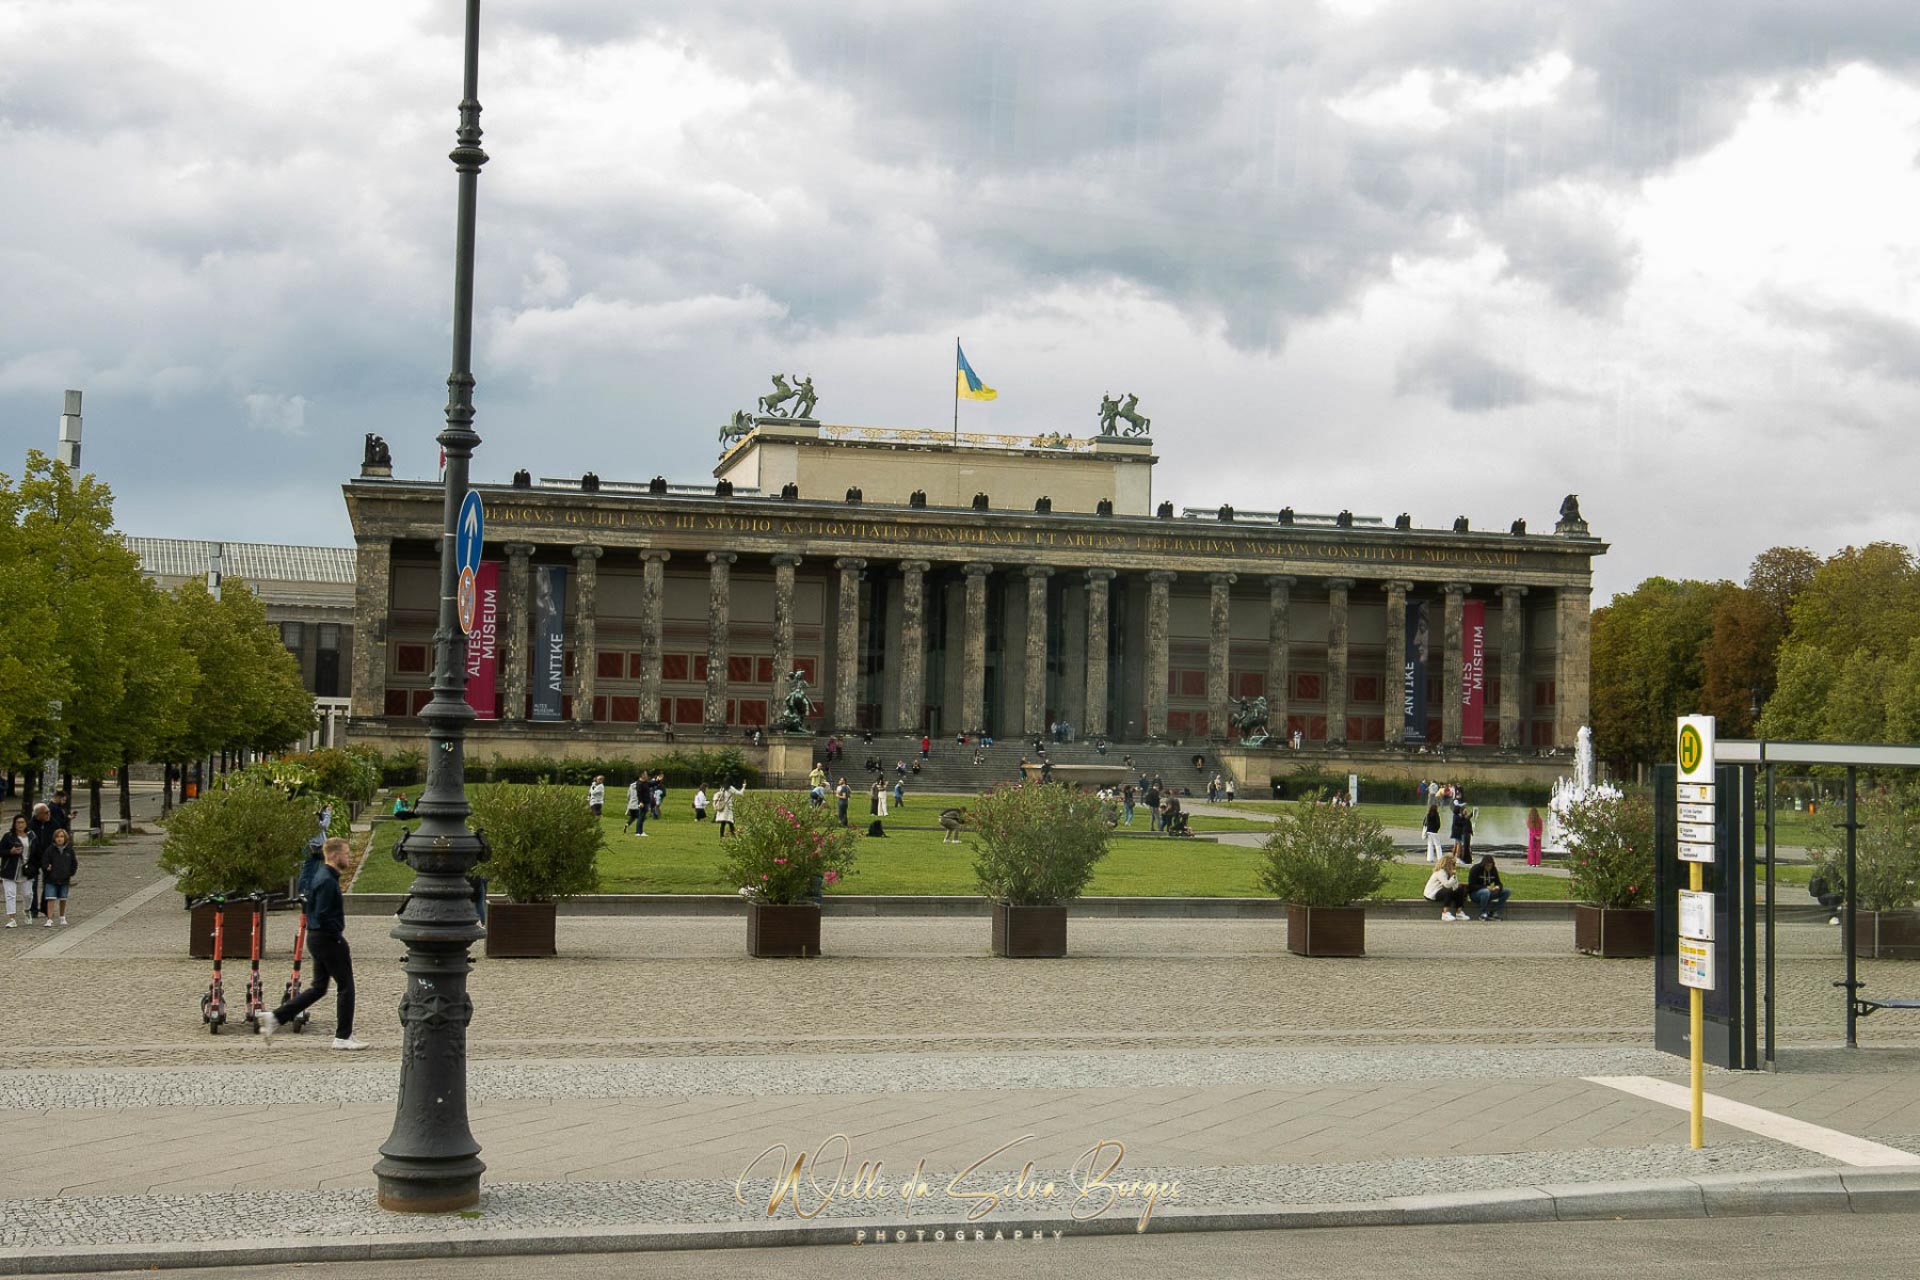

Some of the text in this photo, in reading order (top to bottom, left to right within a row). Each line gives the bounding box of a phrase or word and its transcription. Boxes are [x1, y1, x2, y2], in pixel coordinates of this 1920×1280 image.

[675, 516, 695, 528] III
[705, 516, 771, 531] STVDIO
[1036, 533, 1057, 545] ET
[482, 589, 497, 659] MUSEUM
[467, 629, 481, 677] ALTES
[549, 633, 564, 692] ANTIKE
[1472, 626, 1484, 690] MUSEUM
[1405, 661, 1415, 716] ANTIKE
[1462, 662, 1472, 706] ALTES
[1683, 736, 1693, 762] H
